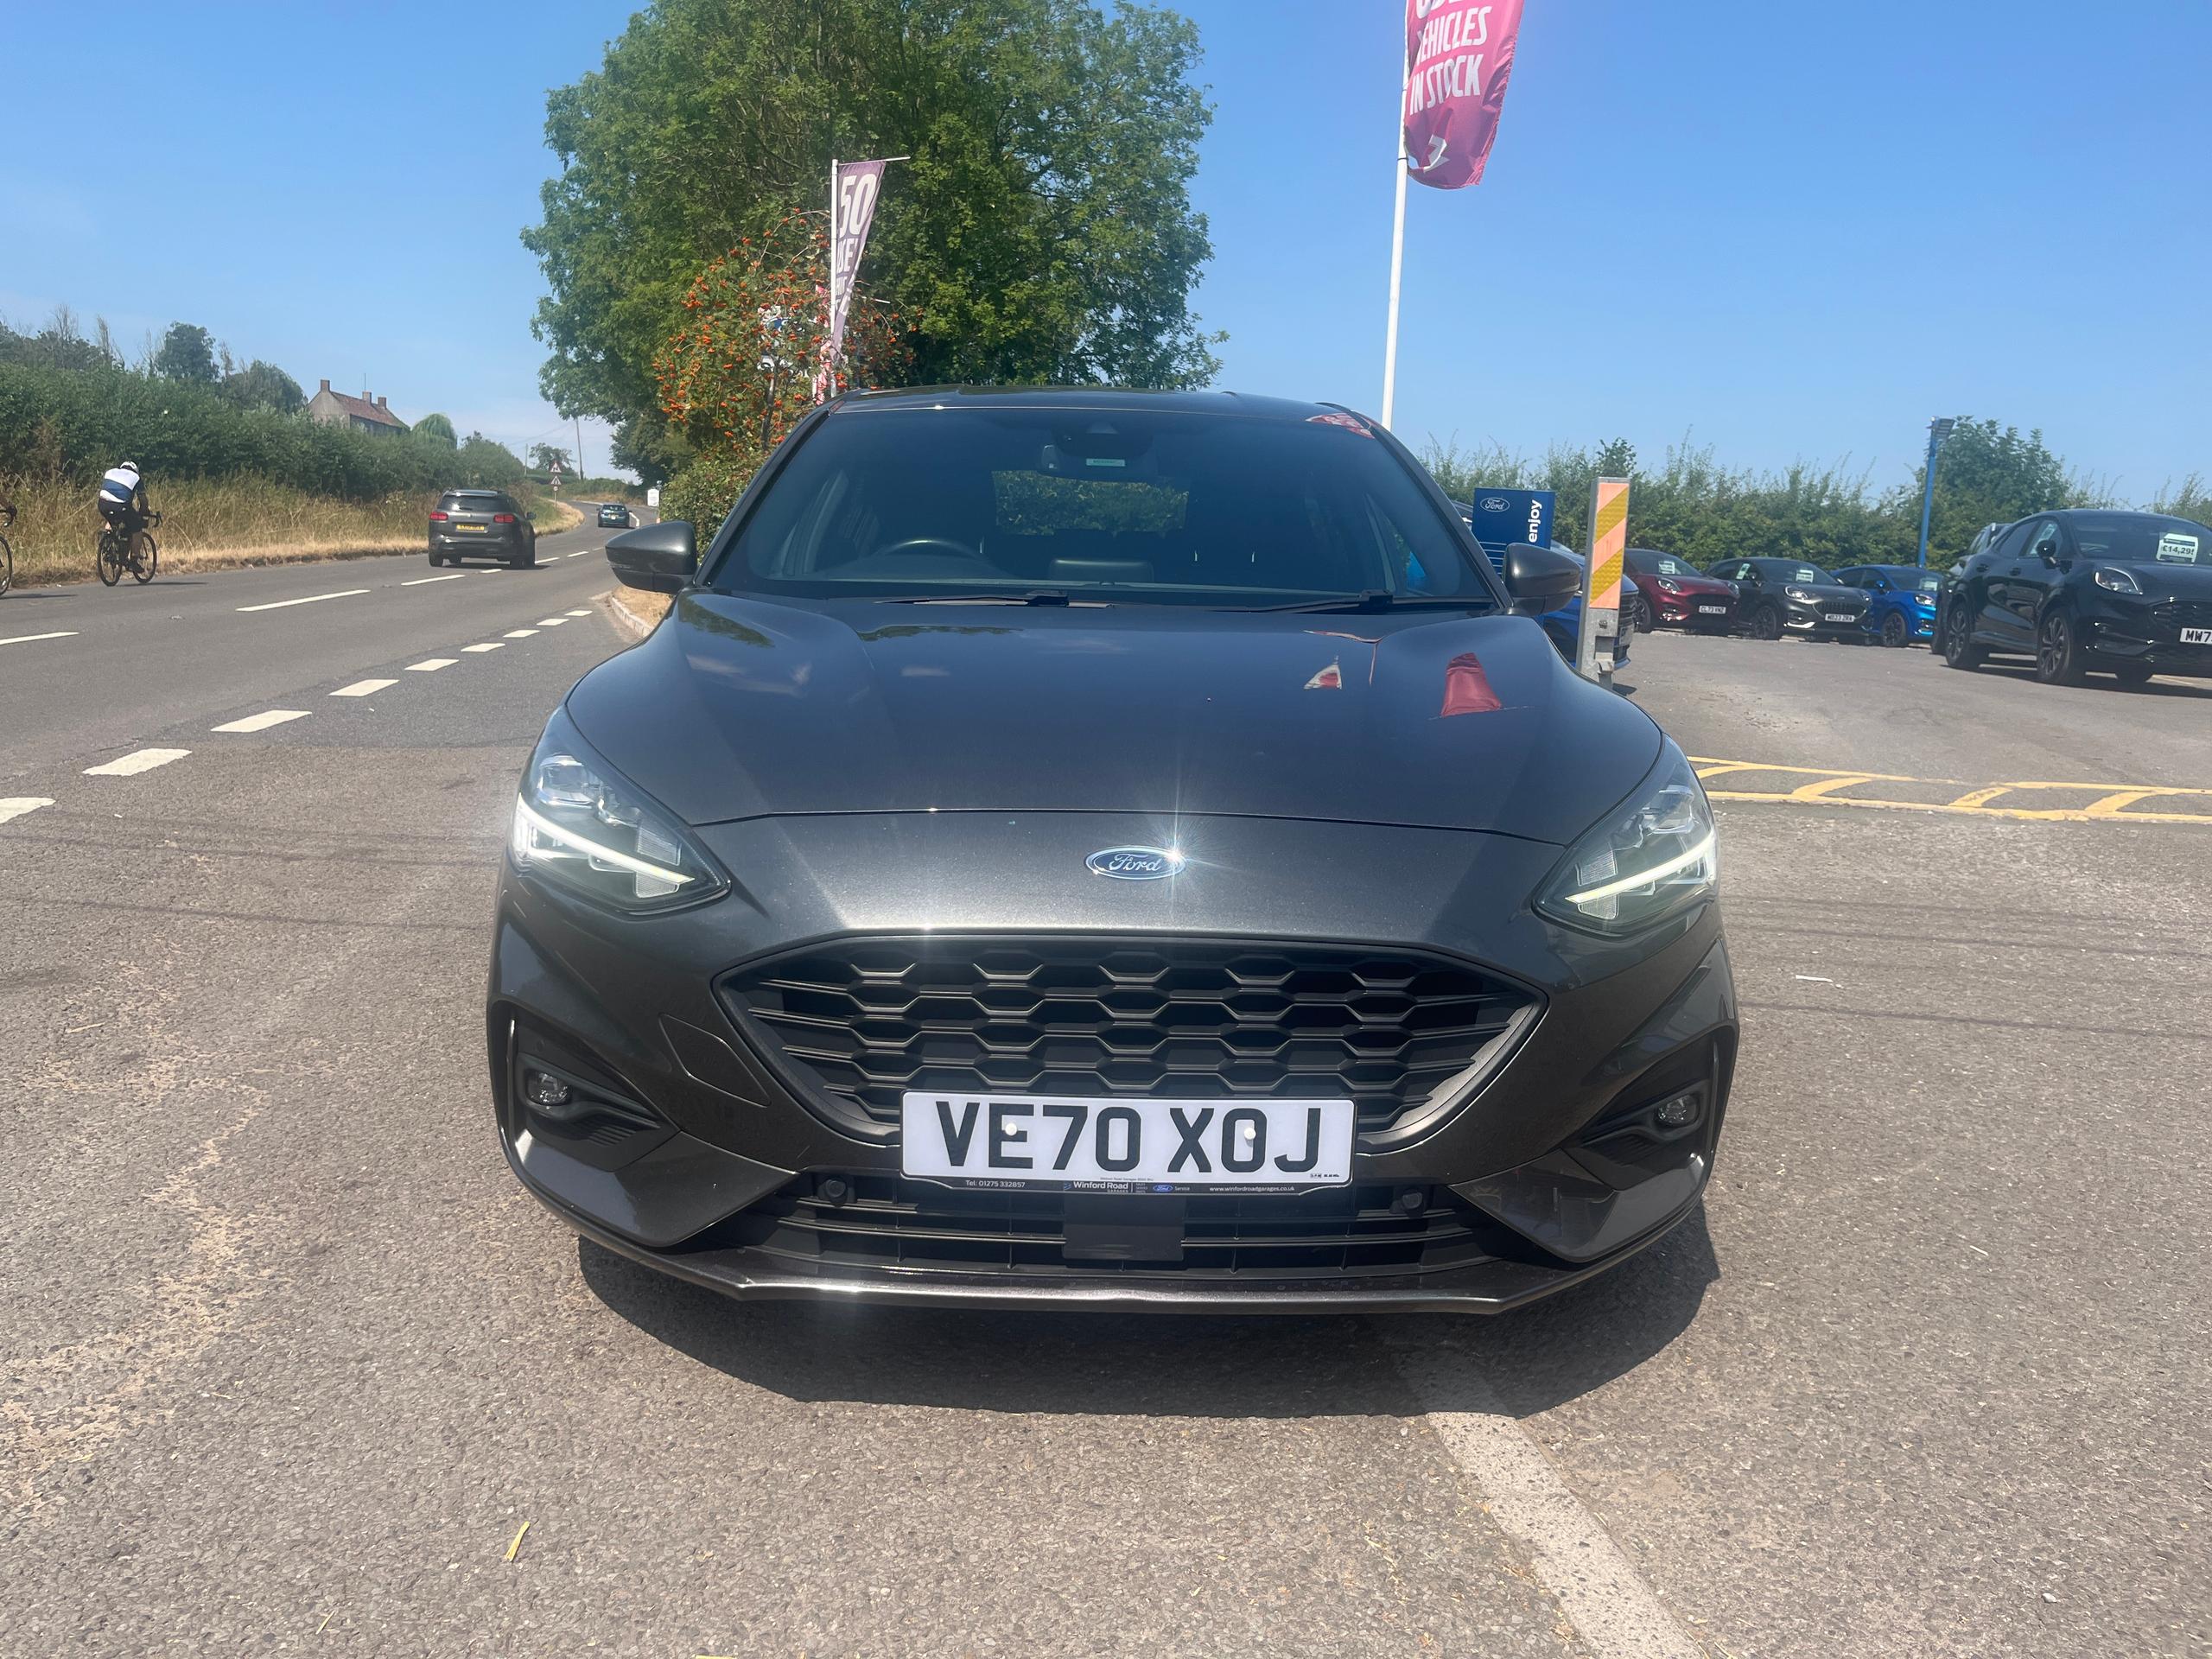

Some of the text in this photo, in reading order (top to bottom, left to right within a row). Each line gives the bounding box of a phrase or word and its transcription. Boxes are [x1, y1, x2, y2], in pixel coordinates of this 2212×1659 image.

[1410, 54, 1484, 116] IN STOCK
[839, 173, 877, 238] 50
[1484, 498, 1505, 510] Ford
[1528, 499, 1542, 543] enjoy
[2185, 630, 2212, 642] MW7
[1109, 853, 1162, 871] Ford
[936, 1101, 1321, 1173] VE70 XOJ
[1107, 1181, 1128, 1190] Road
